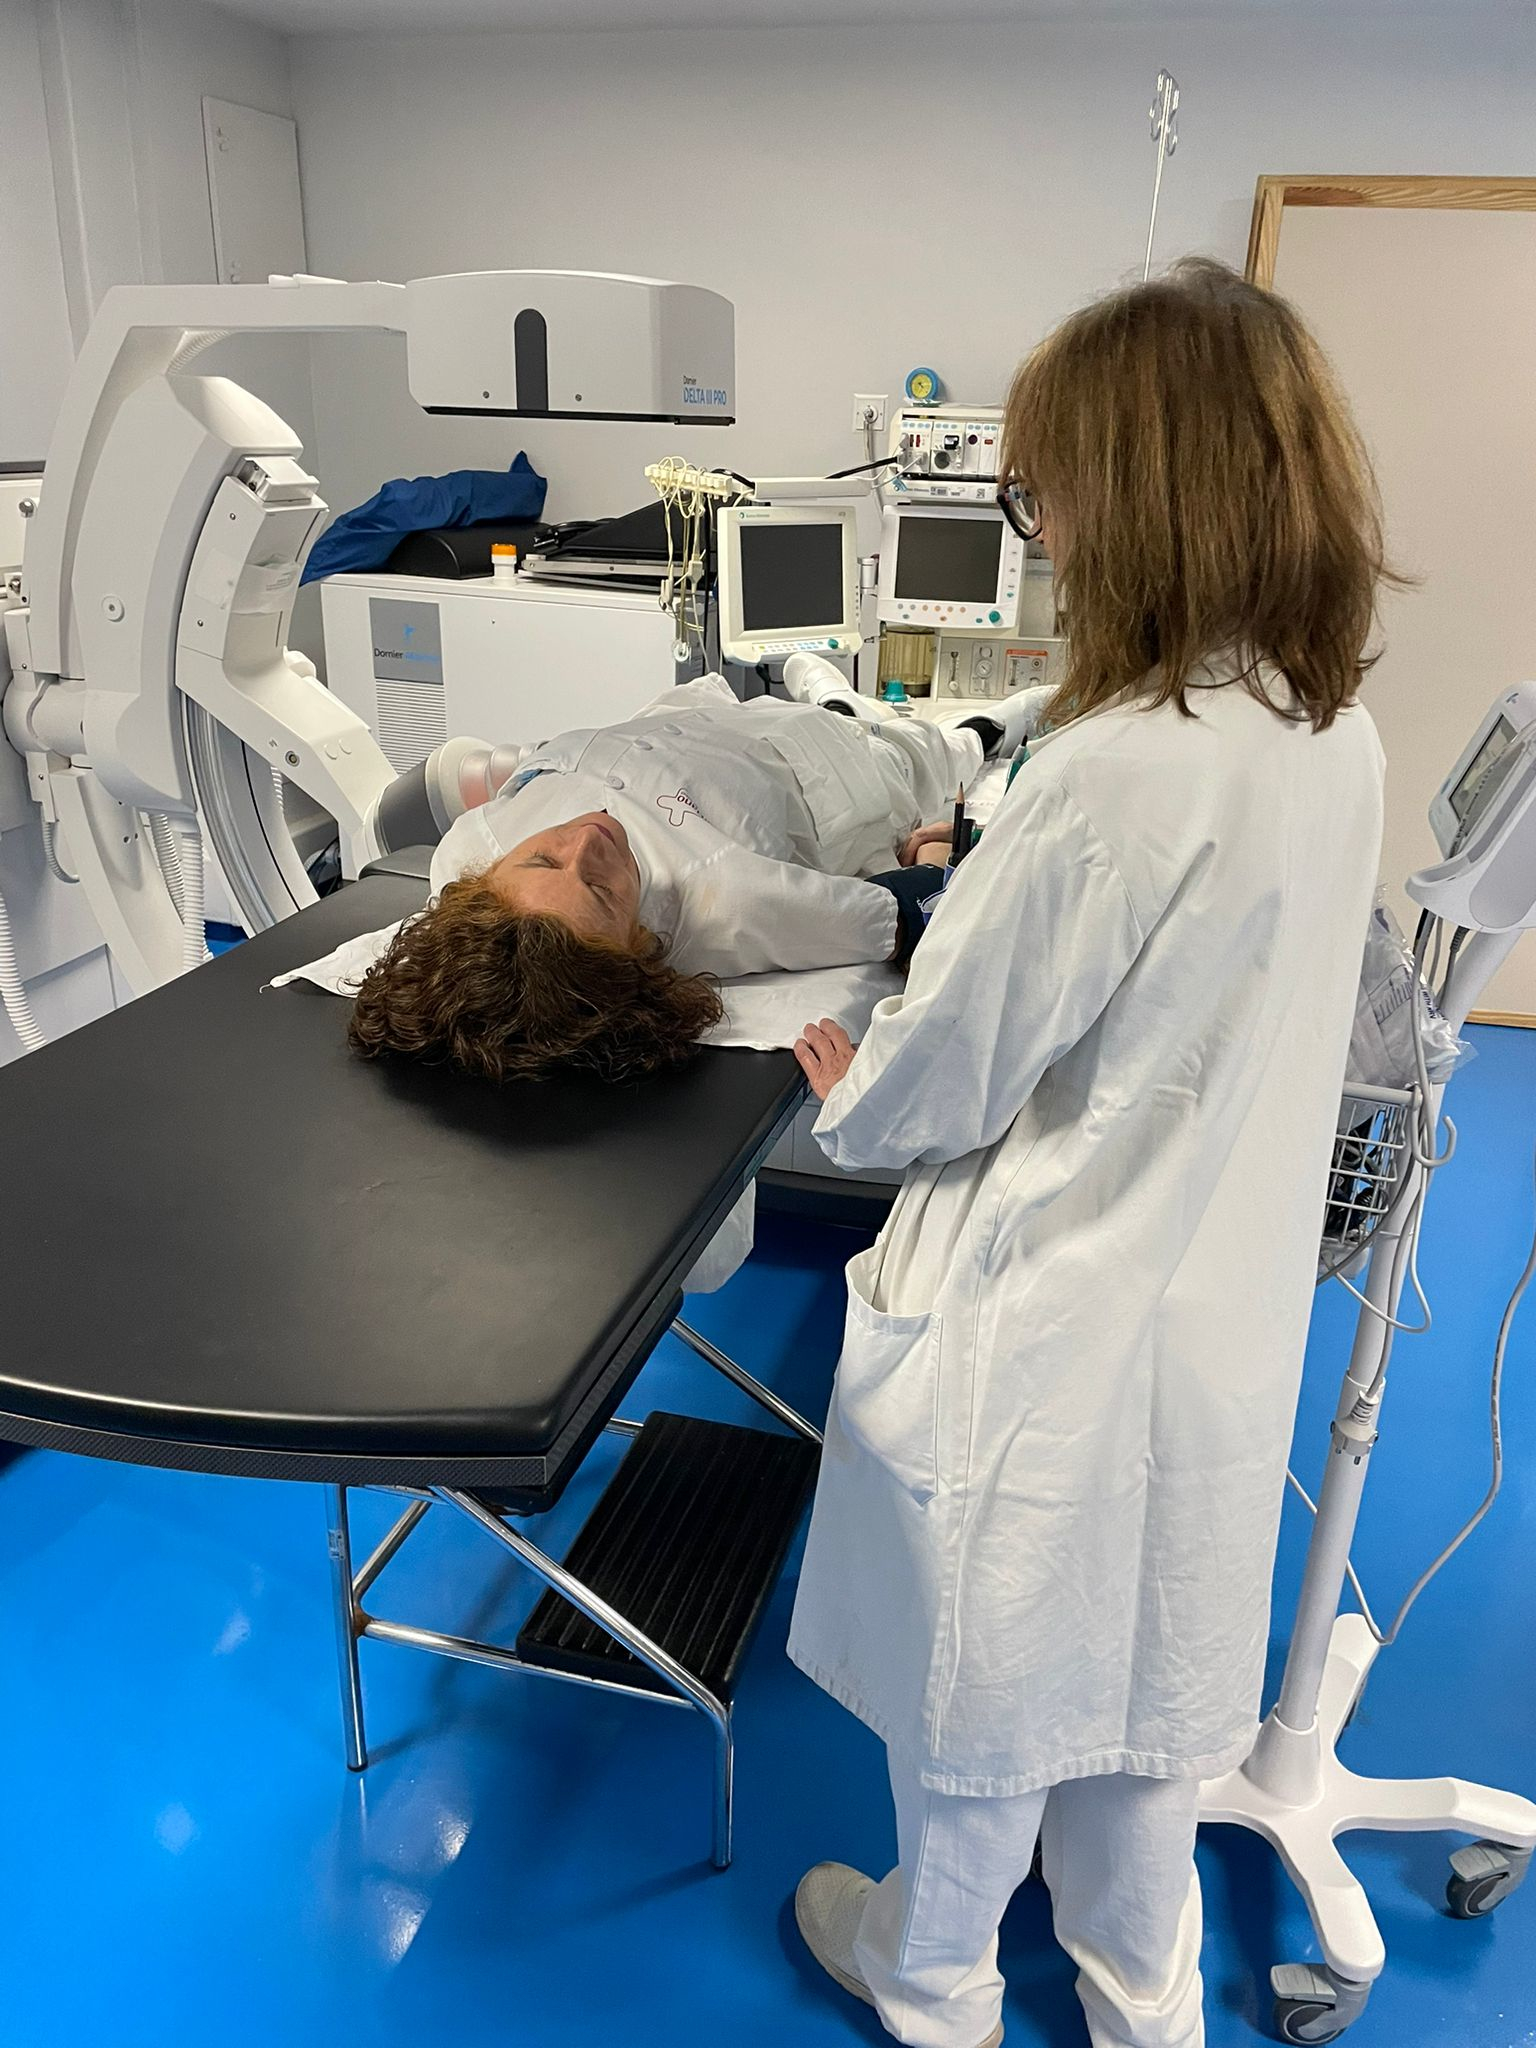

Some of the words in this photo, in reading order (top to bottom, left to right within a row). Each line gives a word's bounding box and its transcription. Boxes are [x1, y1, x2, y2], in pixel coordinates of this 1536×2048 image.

[683, 387, 705, 405] DELTA
[713, 389, 727, 406] PRO
[374, 647, 404, 659] Dornier
